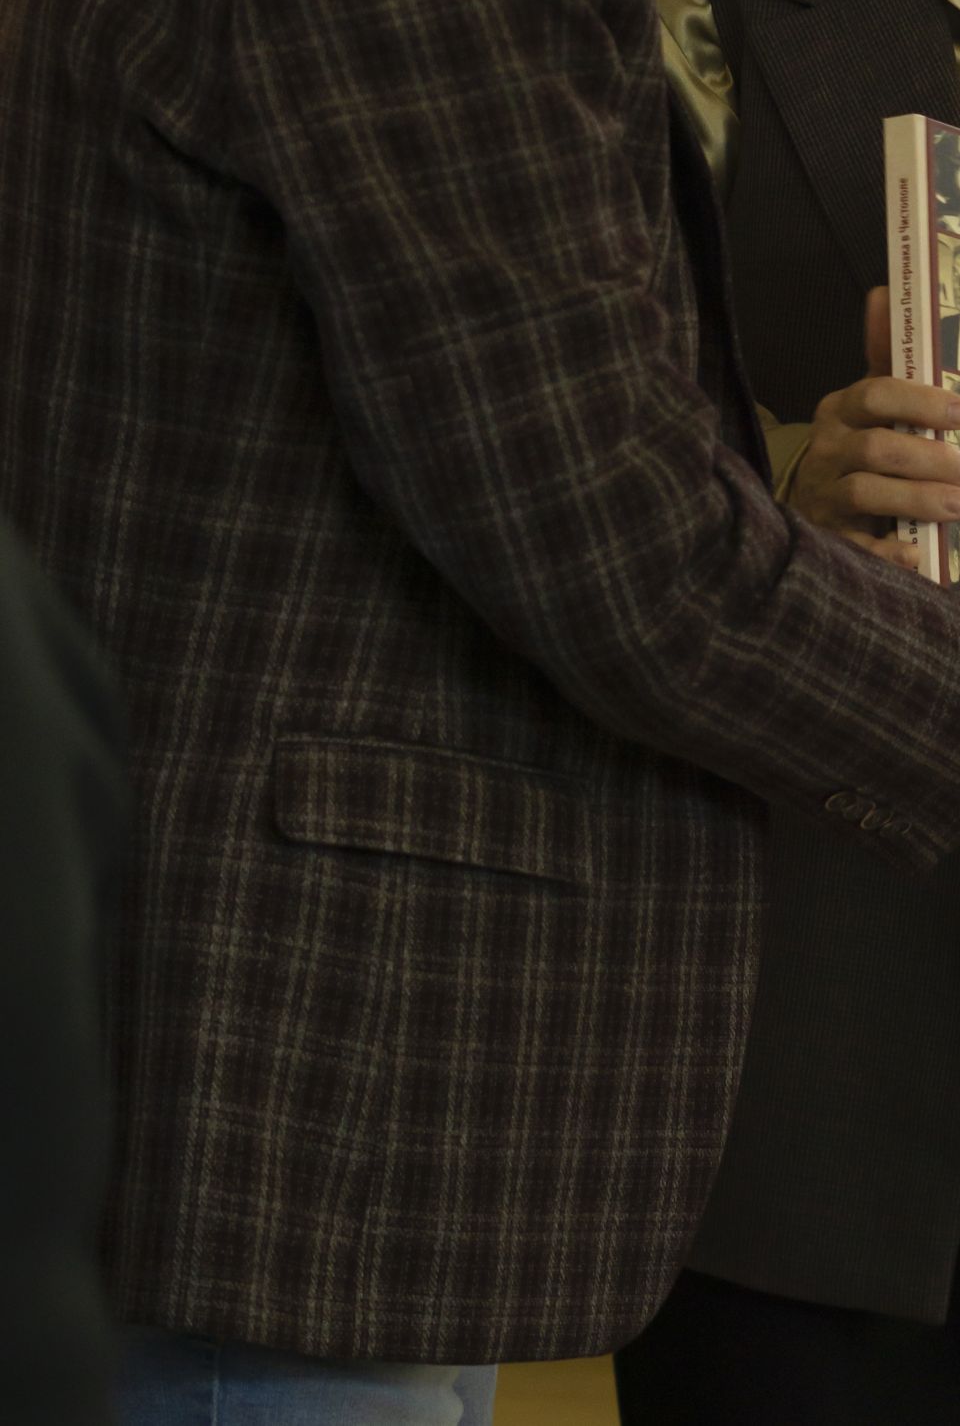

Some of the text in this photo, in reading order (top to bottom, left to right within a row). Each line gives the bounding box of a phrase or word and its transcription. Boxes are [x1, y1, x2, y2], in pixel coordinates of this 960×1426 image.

[898, 177, 909, 233] Чистополе
[901, 244, 913, 305] Пастернака
[902, 307, 914, 344] Бориса
[903, 348, 916, 380] музей
